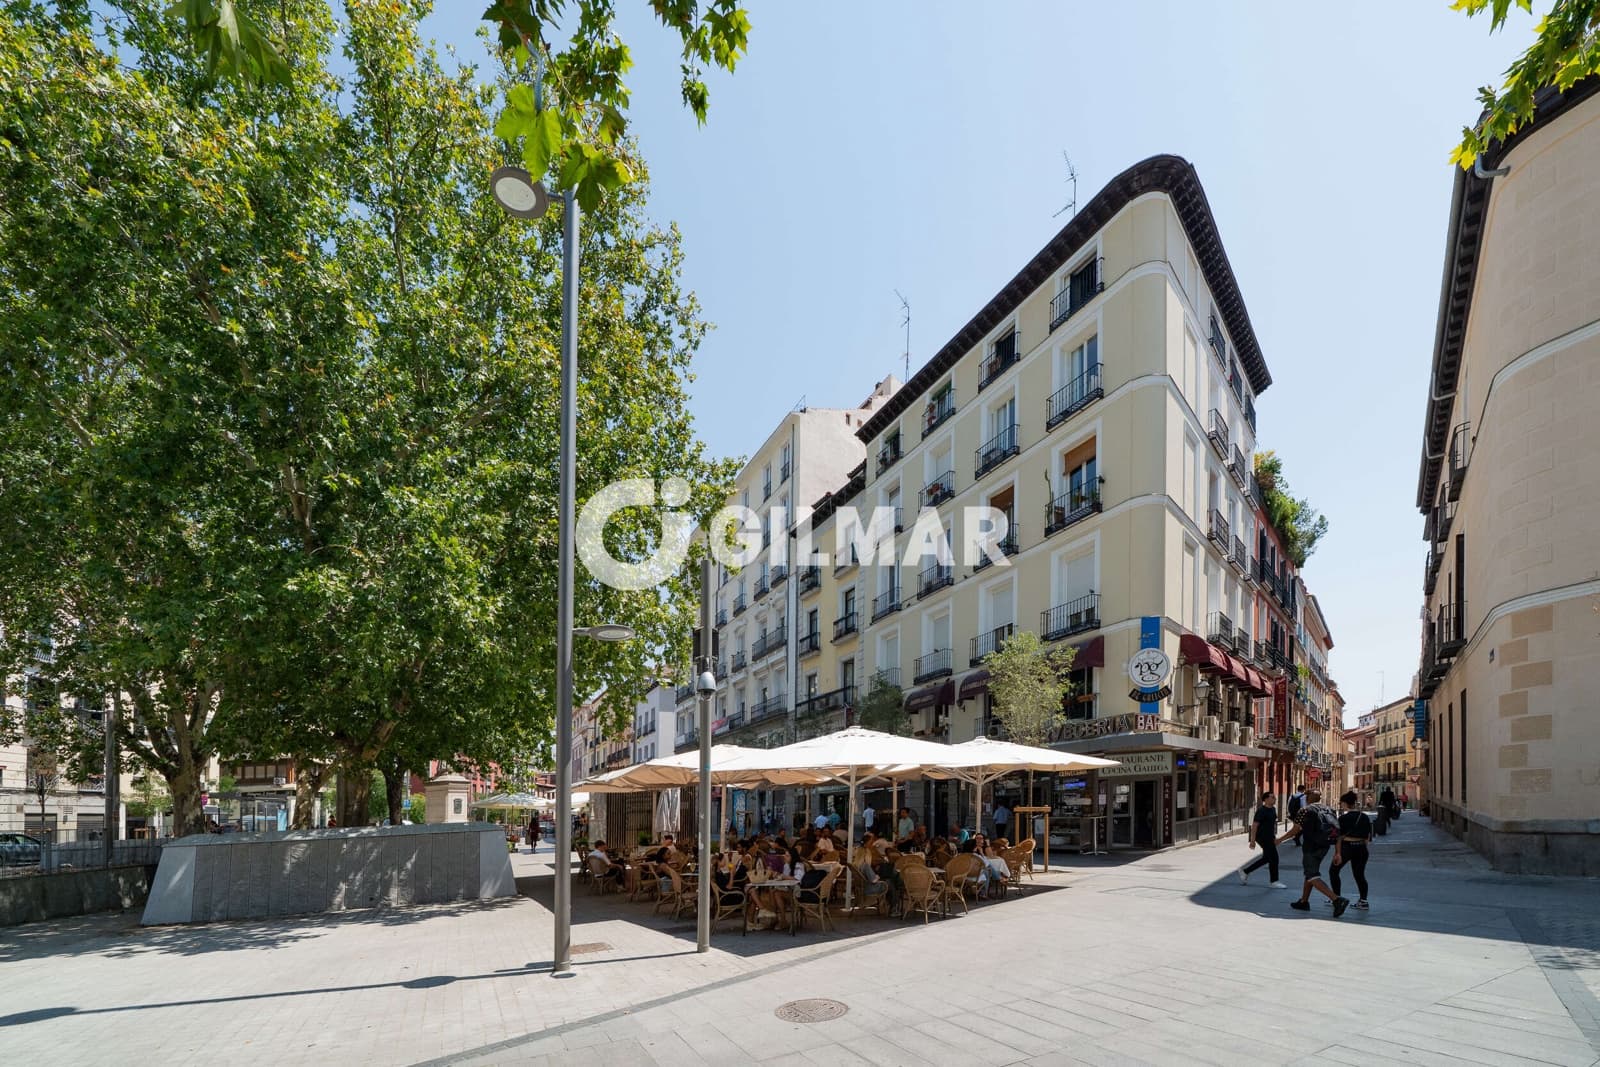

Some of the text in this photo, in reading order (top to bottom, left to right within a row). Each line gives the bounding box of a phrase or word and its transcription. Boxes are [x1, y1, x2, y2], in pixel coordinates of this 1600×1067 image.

[1137, 714, 1161, 730] BAR
[1107, 754, 1166, 764] STAURANTE
[1102, 764, 1168, 774] COCINA GALLEGA
